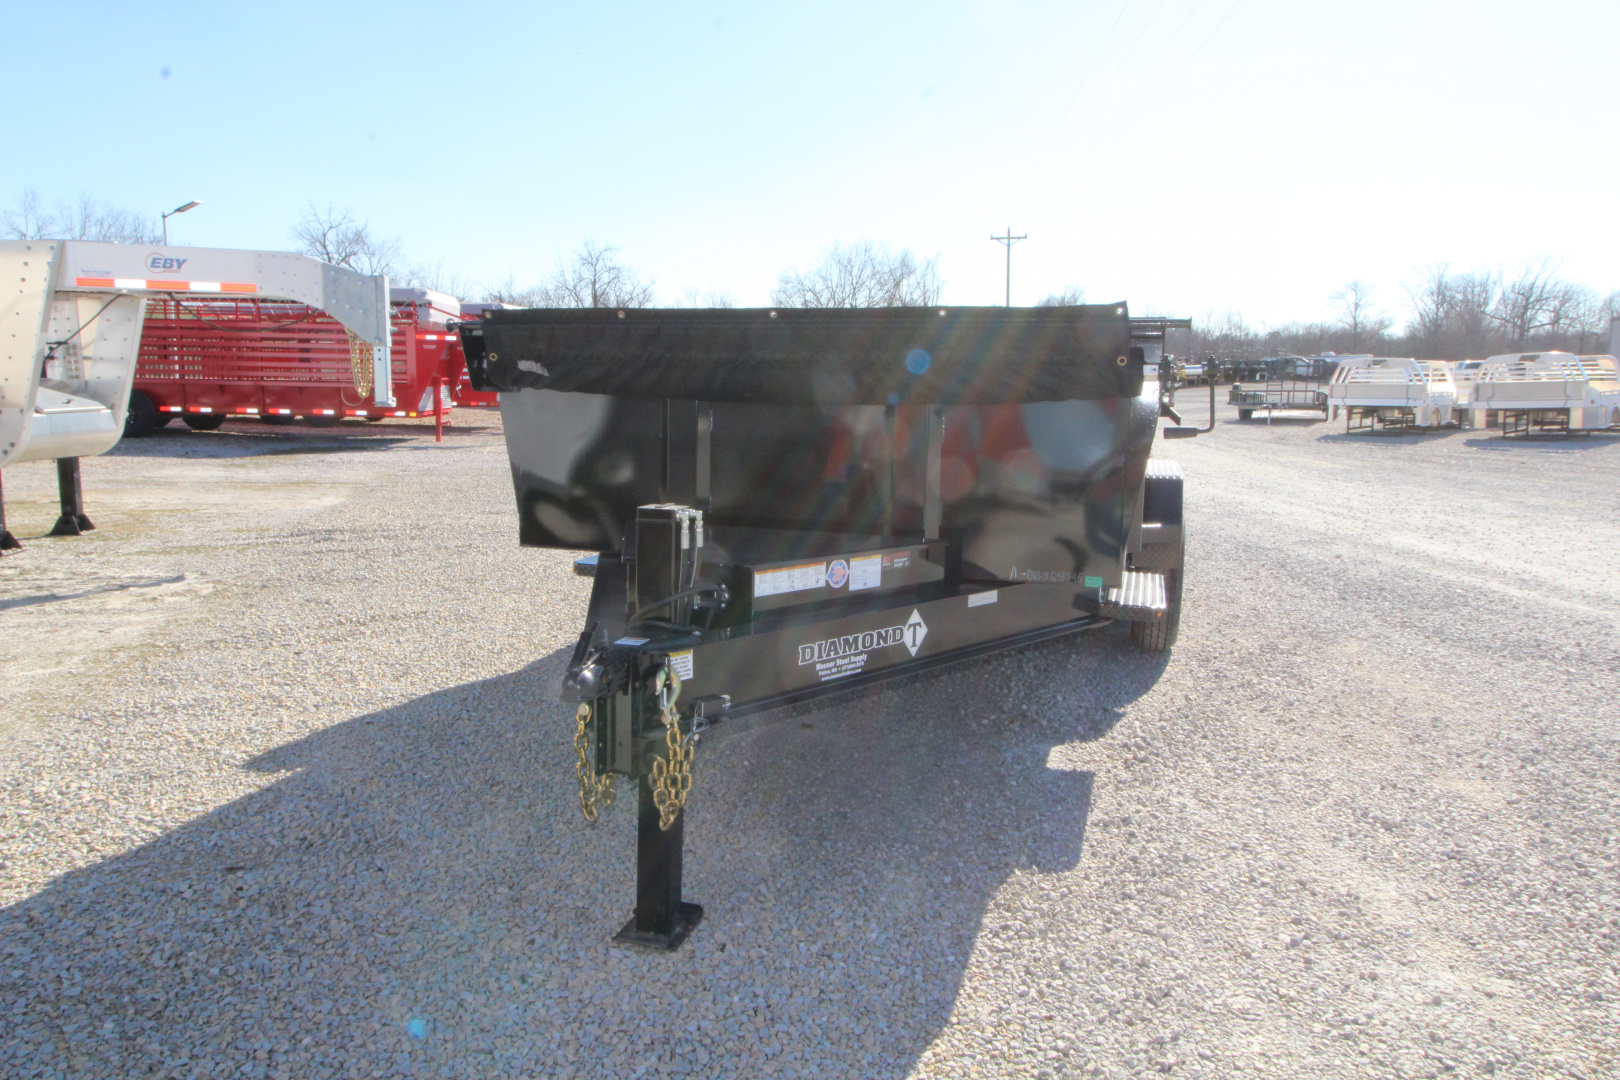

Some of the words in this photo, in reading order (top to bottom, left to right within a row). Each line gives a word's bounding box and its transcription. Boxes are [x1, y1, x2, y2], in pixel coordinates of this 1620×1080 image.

[150, 257, 188, 269] EBY
[798, 625, 905, 666] DIAMOND
[906, 621, 922, 648] T
[816, 661, 835, 671] Mouser
[836, 657, 850, 666] Steel
[850, 653, 868, 663] Supply
